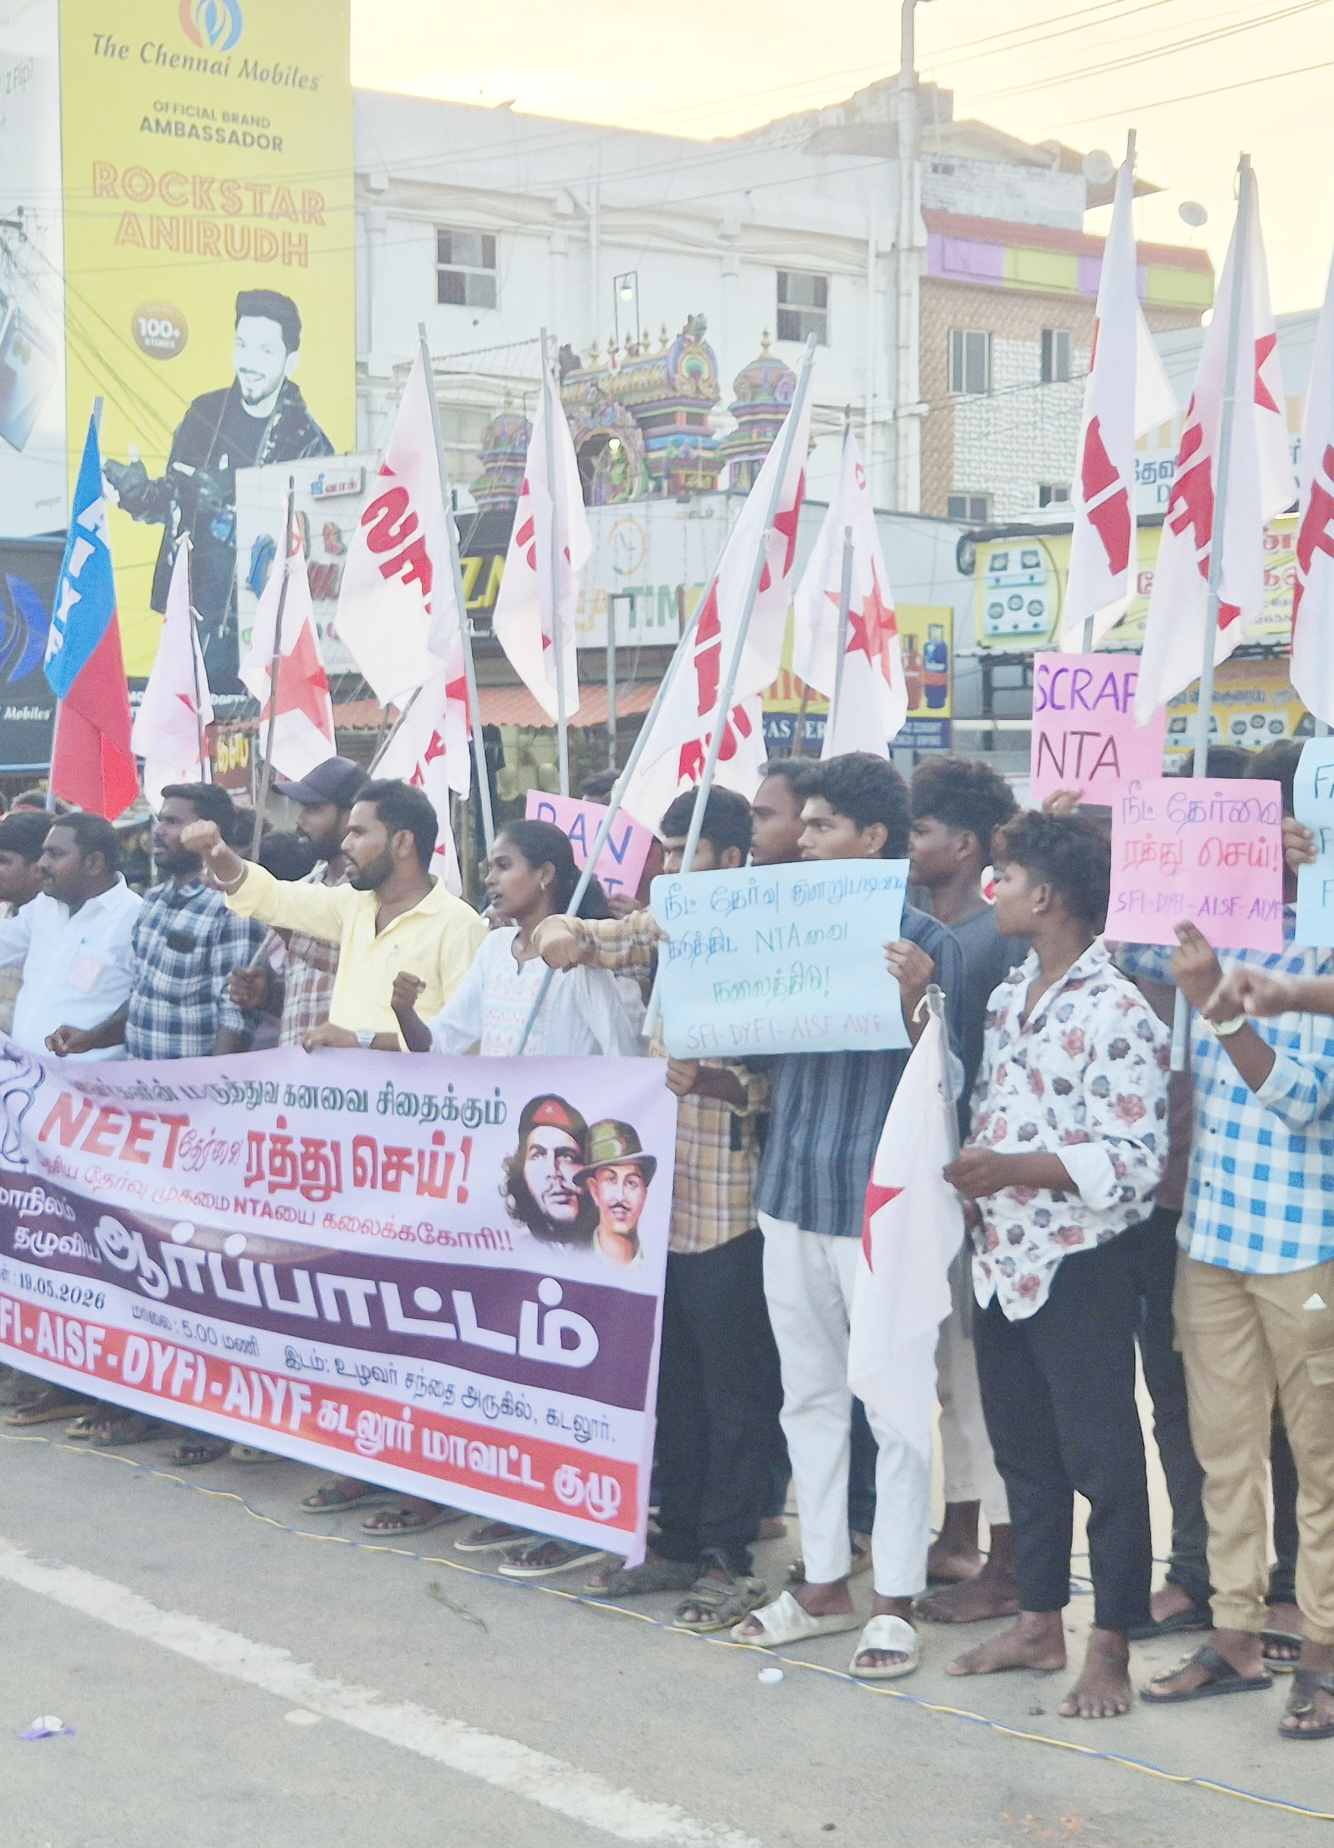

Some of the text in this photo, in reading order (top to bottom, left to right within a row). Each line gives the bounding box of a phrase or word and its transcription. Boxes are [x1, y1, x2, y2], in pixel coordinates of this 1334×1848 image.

[92, 33, 321, 91] The Chennai Mobiles
[138, 116, 284, 152] AMBASSADOR
[153, 100, 271, 130] OFFICIAL BRAND
[92, 160, 328, 227] ROCKSTAR
[114, 210, 310, 269] ANIRUDH
[1037, 731, 1122, 781] NTA
[376, 1080, 508, 1129] சிதைக்கும்
[38, 1090, 191, 1169] NEET
[244, 1114, 344, 1203] ரத்து
[352, 1129, 474, 1205] செய்!
[19, 1270, 106, 1311] 19.05.2026
[182, 1321, 219, 1347] 5.00
[93, 1215, 600, 1369] ஆர்ப்பாட்டம்
[316, 1397, 416, 1457] கடலூர்
[421, 1427, 546, 1491] மாவட்ட
[552, 1461, 623, 1520] குழு
